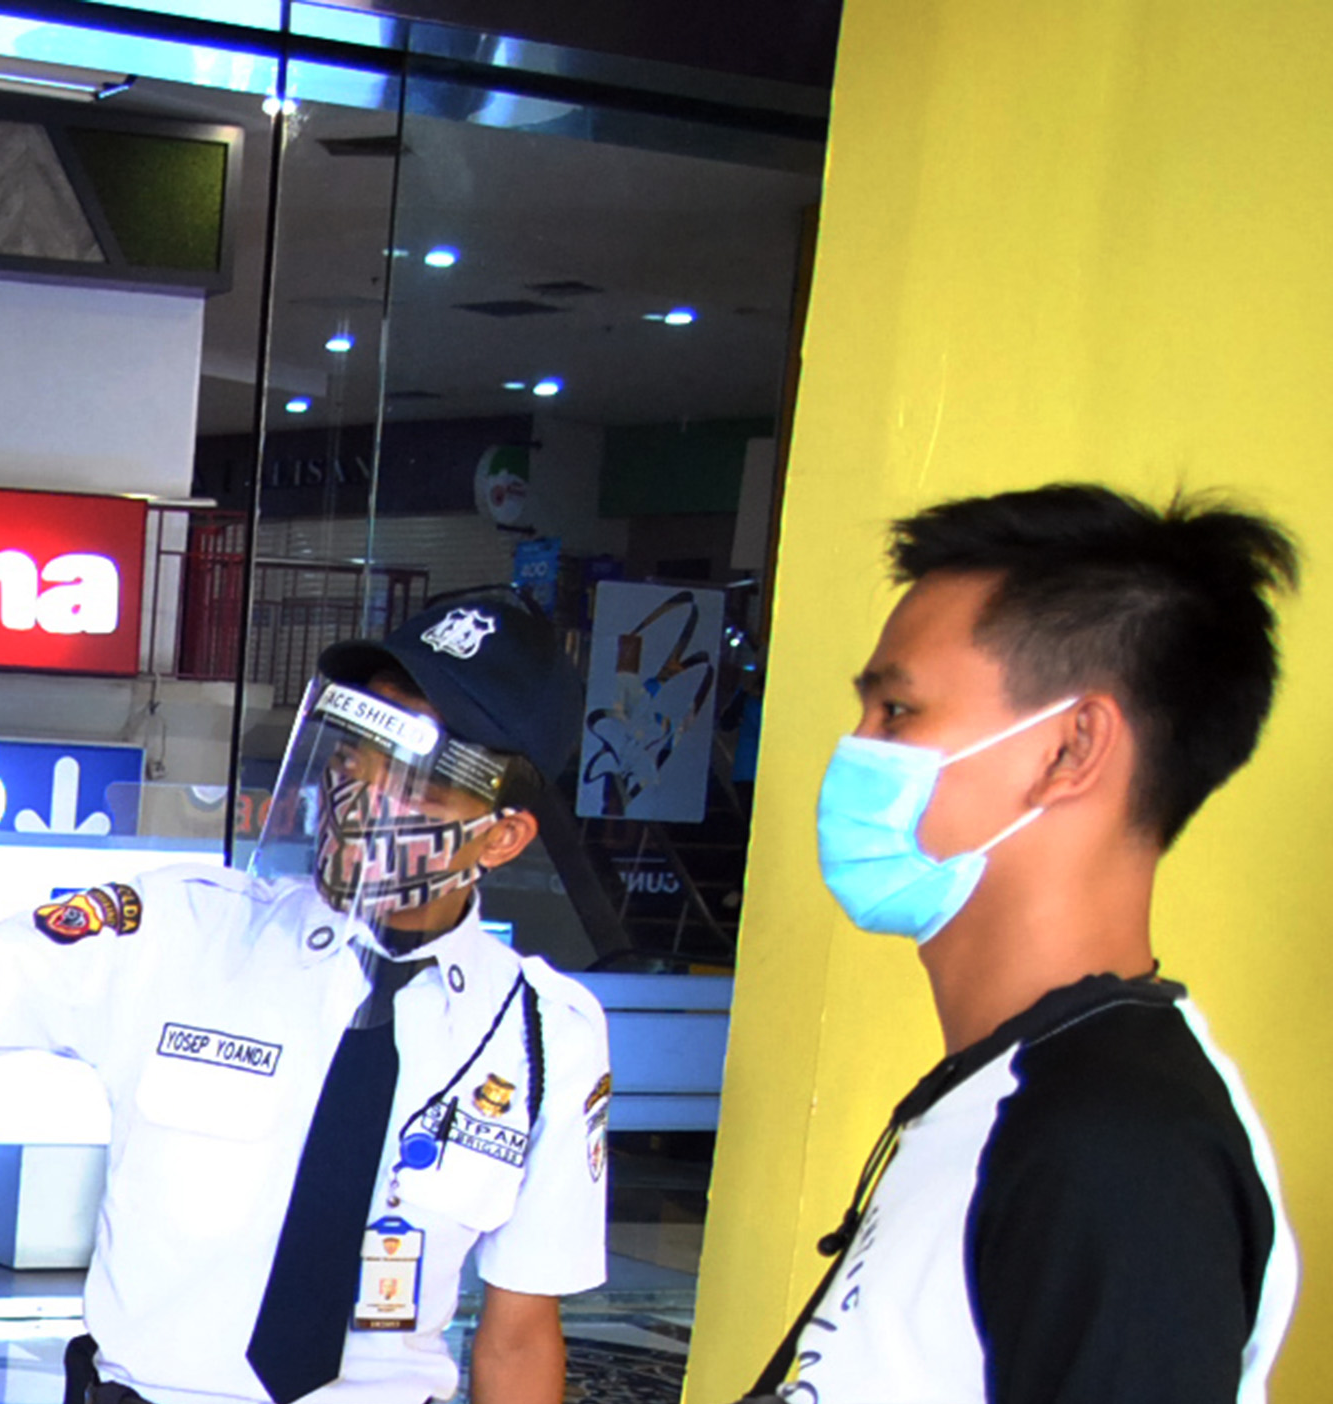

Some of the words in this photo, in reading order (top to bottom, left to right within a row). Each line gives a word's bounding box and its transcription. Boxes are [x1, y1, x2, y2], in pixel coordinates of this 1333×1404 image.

[166, 1030, 210, 1054] YOSEP
[216, 1039, 272, 1069] YOANDA
[425, 1104, 526, 1150] STPAM
